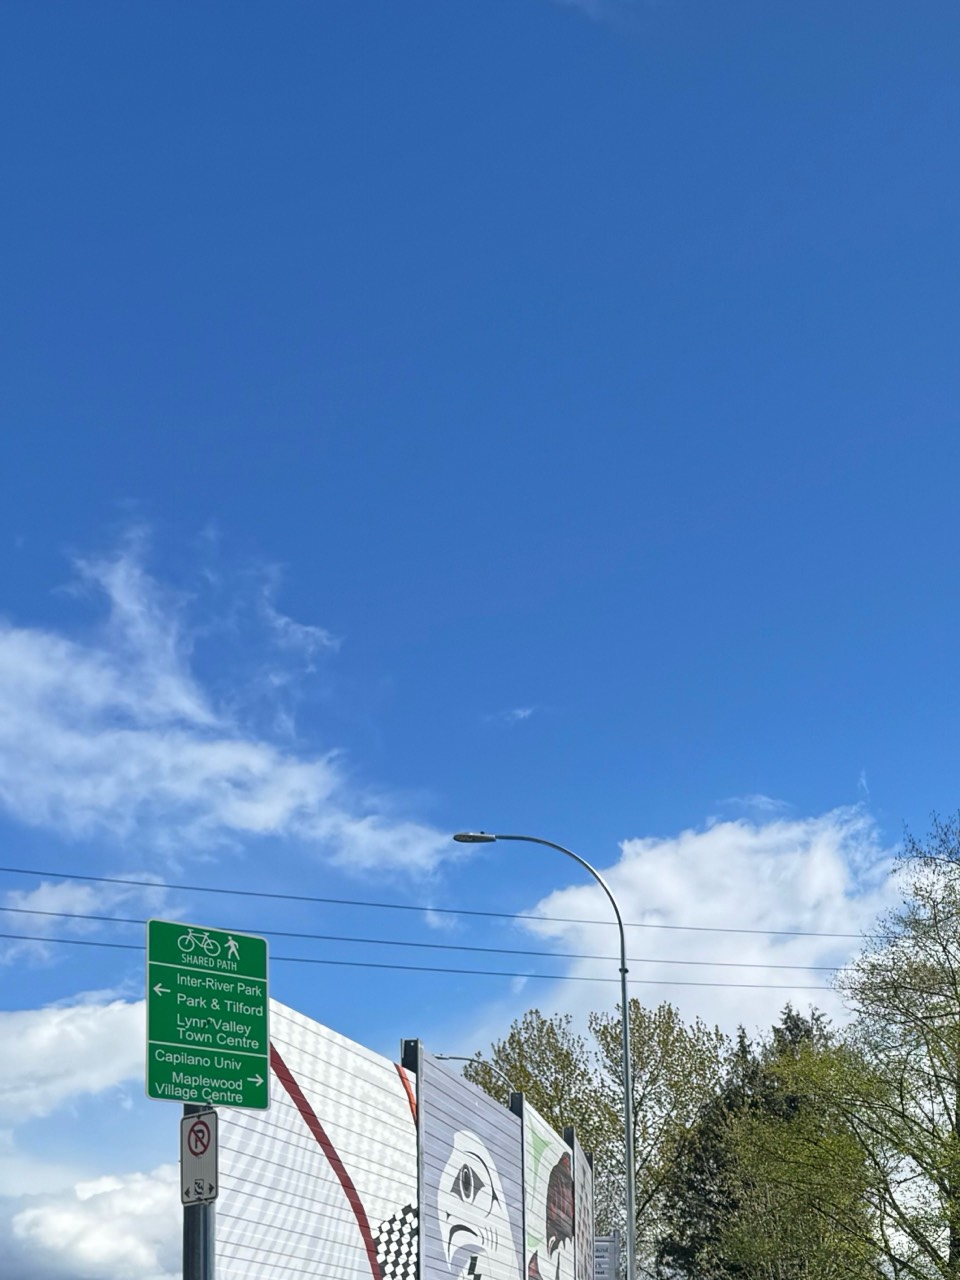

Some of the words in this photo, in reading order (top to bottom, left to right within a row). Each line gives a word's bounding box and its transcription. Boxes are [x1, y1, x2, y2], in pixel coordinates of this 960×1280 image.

[181, 953, 215, 967] SHARED
[217, 959, 237, 971] PATH
[177, 973, 234, 992] Inter-River
[237, 983, 262, 997] Park
[177, 993, 207, 1009] Park
[211, 998, 220, 1010] &
[224, 1000, 263, 1016] Tilford
[177, 1027, 213, 1043] Town
[216, 1033, 259, 1049] Centre
[211, 1019, 251, 1037] Valley
[155, 1049, 211, 1066] Capilano
[214, 1056, 242, 1070] Univ
[172, 1071, 243, 1090] Maplewood
[155, 1082, 198, 1100] Village
[201, 1088, 243, 1103] Centre
